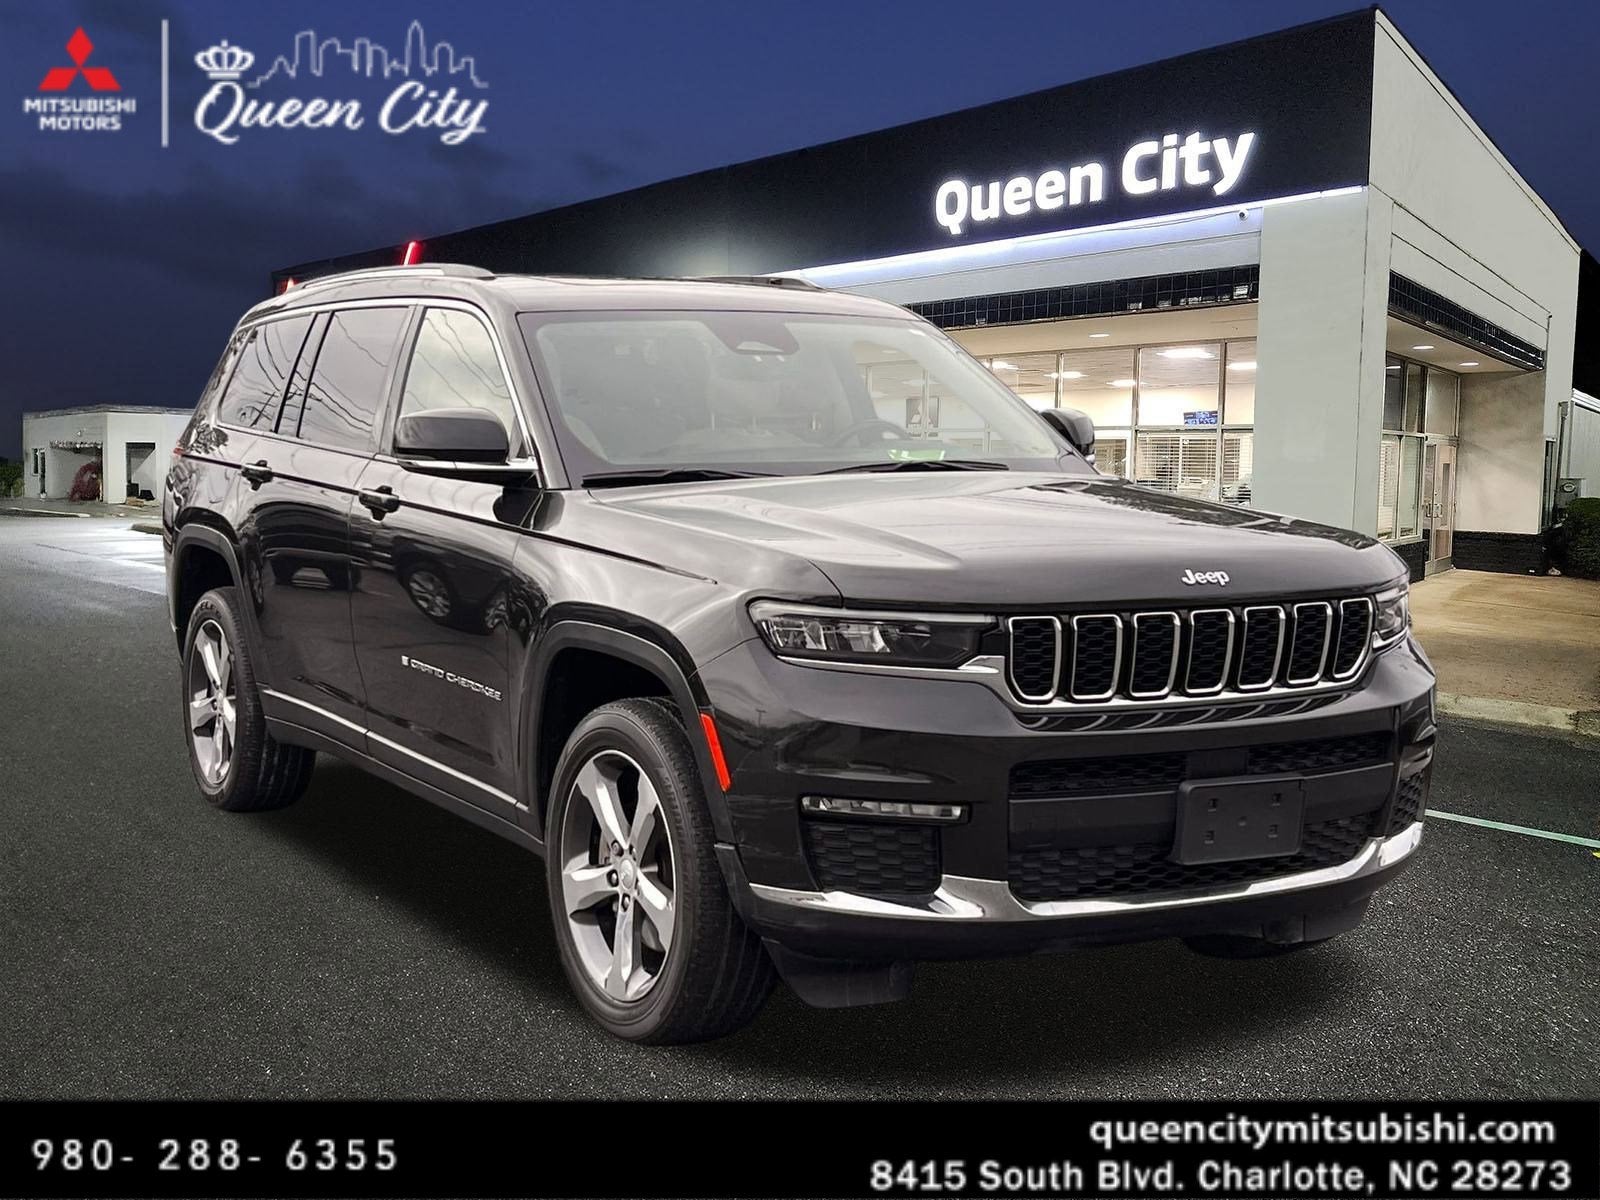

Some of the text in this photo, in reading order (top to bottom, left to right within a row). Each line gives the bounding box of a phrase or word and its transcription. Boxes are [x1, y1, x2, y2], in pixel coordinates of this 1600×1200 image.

[935, 131, 1255, 234] Queen City
[1181, 569, 1230, 586] Jeep
